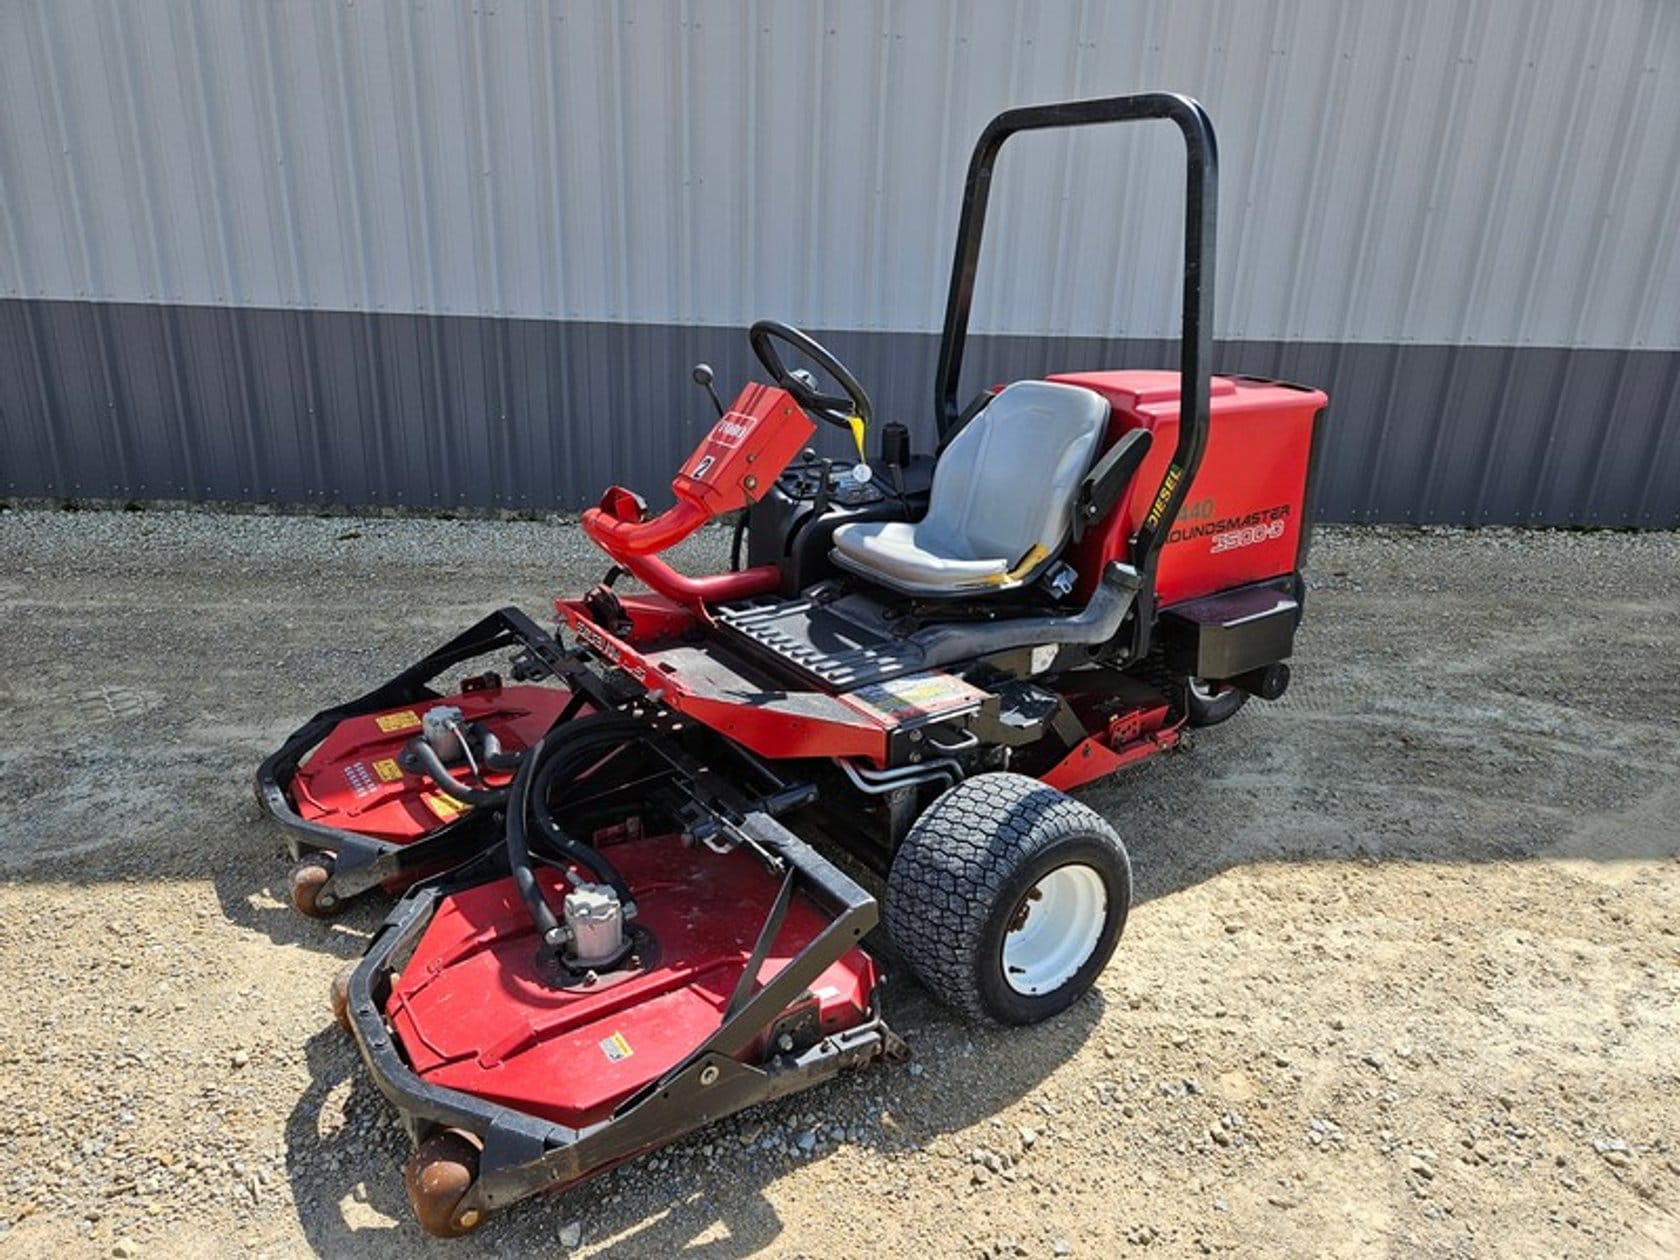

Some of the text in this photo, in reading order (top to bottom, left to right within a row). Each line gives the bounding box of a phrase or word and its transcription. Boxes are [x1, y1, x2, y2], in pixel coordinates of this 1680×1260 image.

[693, 457, 711, 477] 2
[1148, 469, 1183, 527] DIESEL
[1165, 504, 1290, 543] OUNDSMASTER
